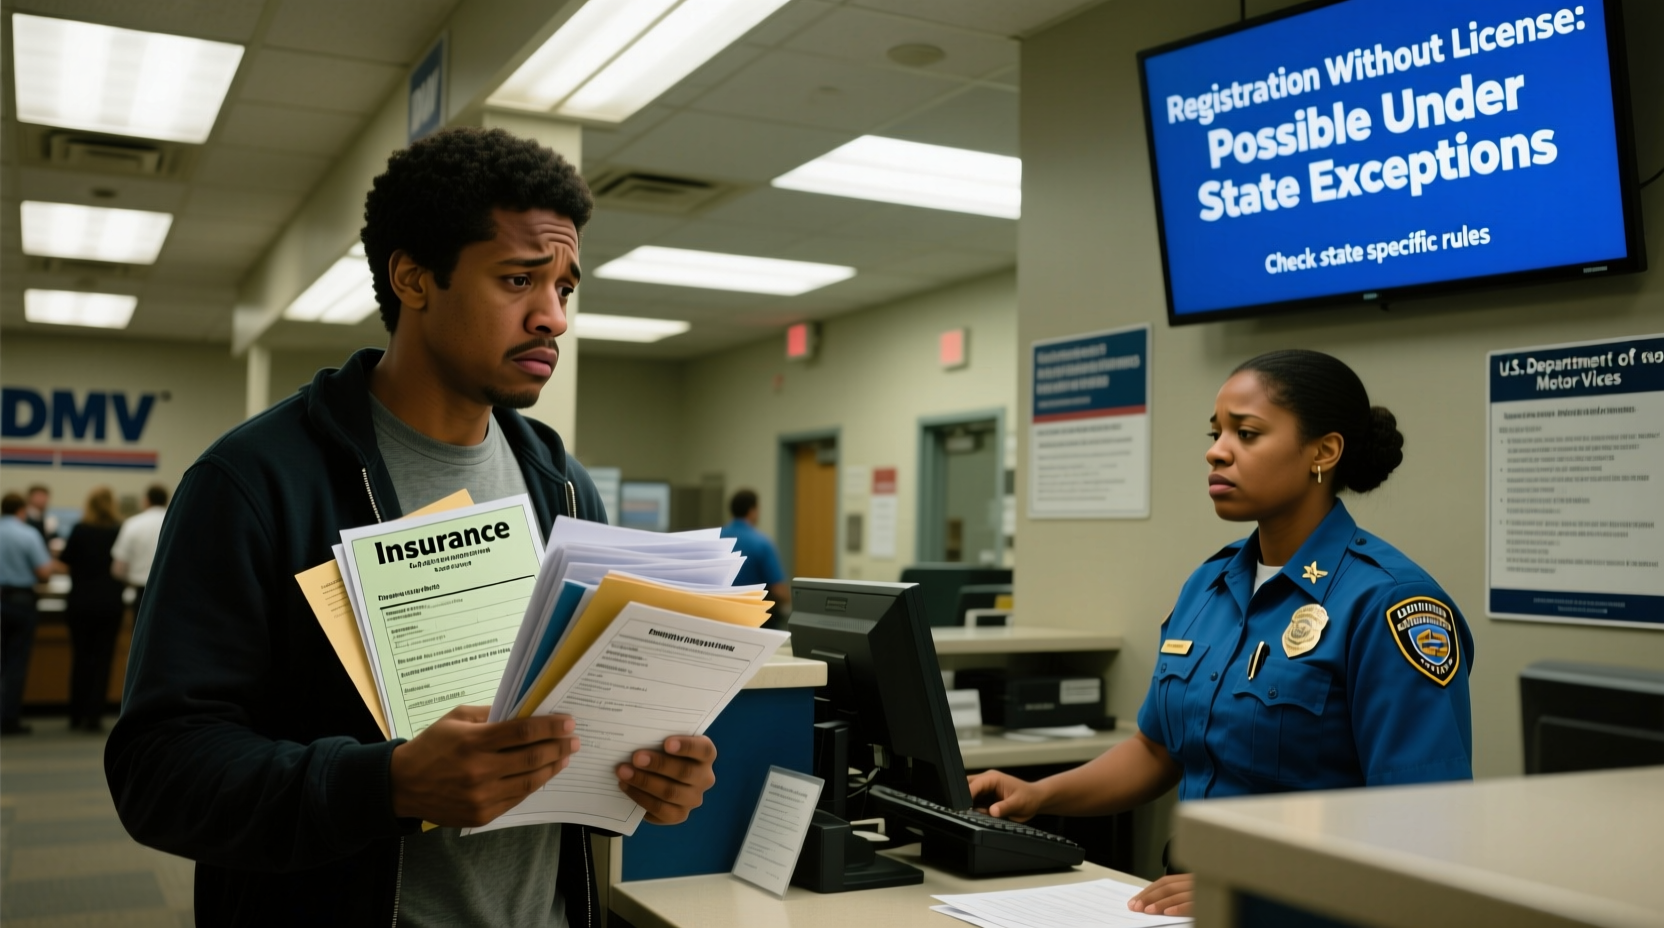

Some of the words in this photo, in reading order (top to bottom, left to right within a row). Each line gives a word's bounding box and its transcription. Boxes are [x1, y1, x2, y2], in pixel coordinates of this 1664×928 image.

[1166, 66, 1321, 125] Registration
[1325, 34, 1445, 86] Without
[1451, 5, 1586, 58] License:
[1208, 101, 1371, 168] Possible
[1382, 73, 1525, 134] Under
[1198, 173, 1301, 222] State
[1308, 128, 1558, 203] Exceptions
[1264, 247, 1318, 274] Check
[1320, 243, 1364, 267] state
[1367, 230, 1438, 263] specific
[1442, 224, 1491, 250] rules
[1500, 359, 1525, 377] U.S.
[1618, 347, 1636, 366] of
[1536, 374, 1581, 391] Motor
[1, 388, 155, 441] DMV
[375, 522, 510, 564] Insurance
